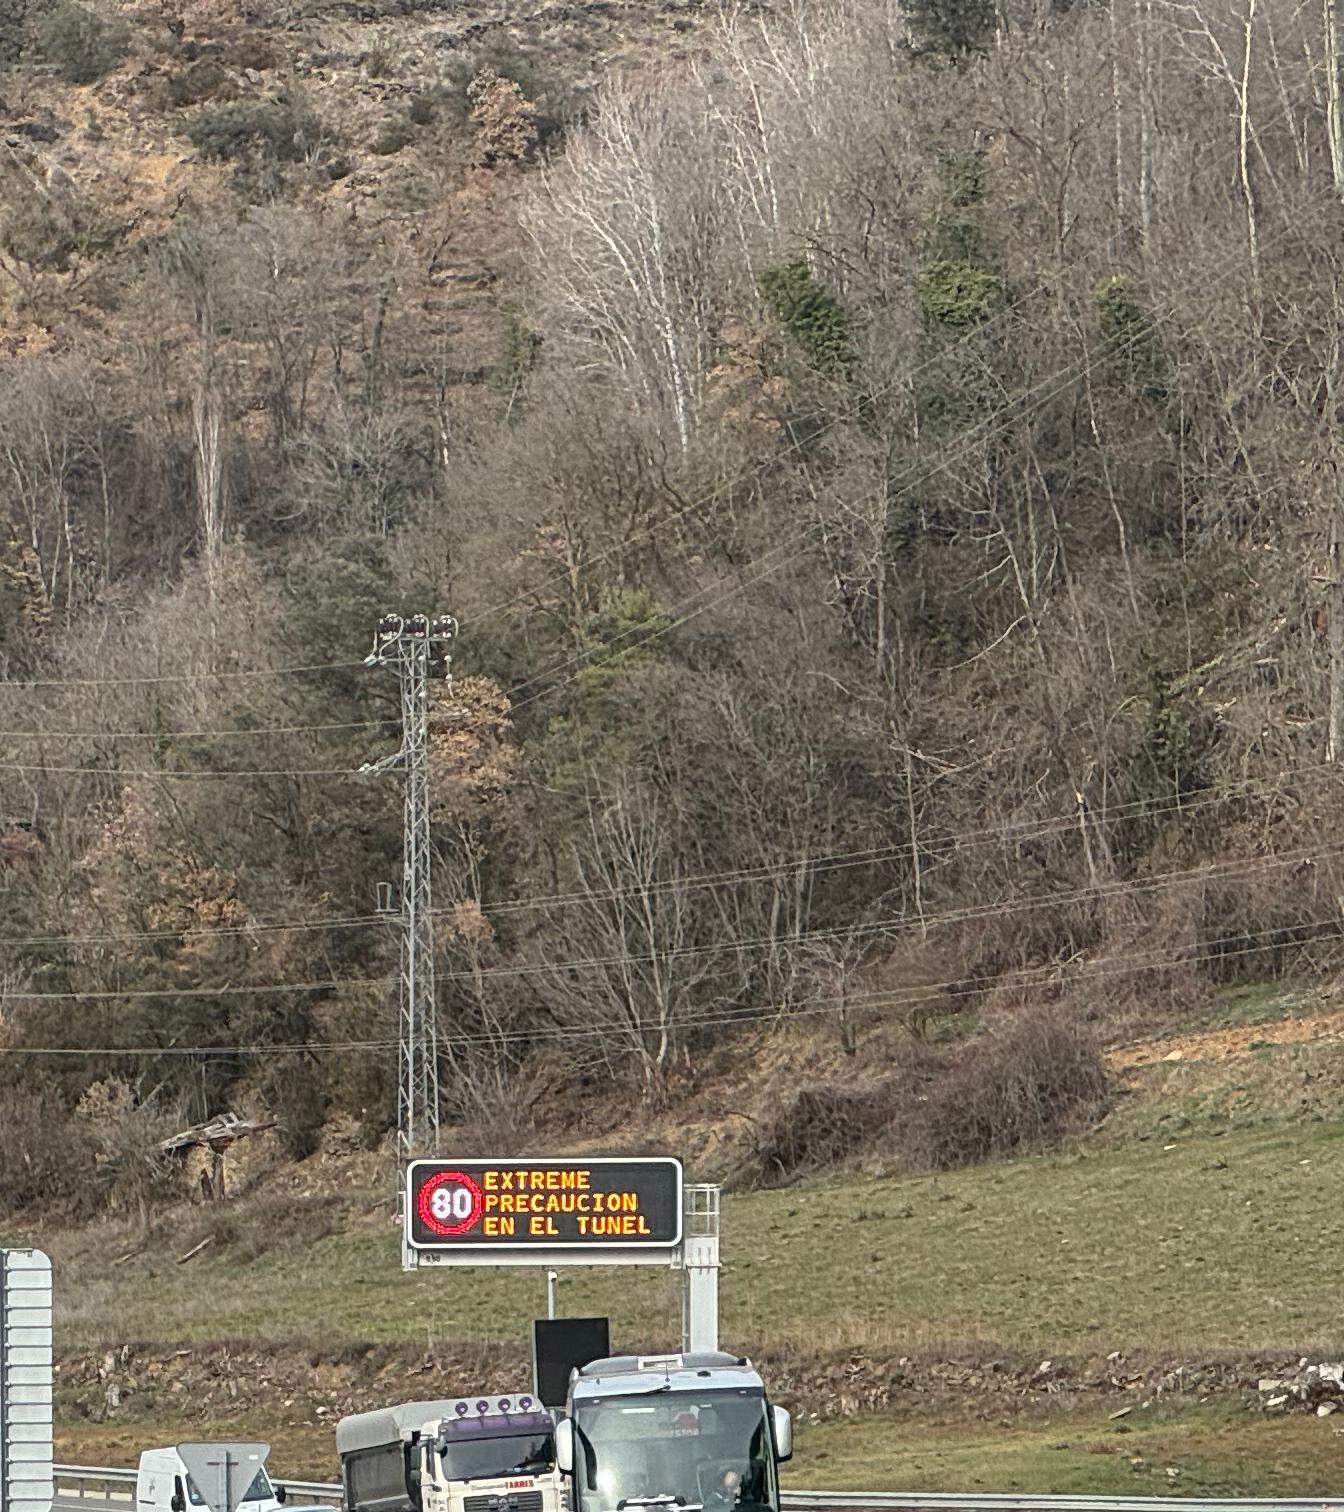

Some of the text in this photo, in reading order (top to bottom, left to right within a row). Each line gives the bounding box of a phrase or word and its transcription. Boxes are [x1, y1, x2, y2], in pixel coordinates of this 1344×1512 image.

[484, 1171, 591, 1190] EXTREME
[431, 1188, 472, 1219] 80
[485, 1193, 637, 1213] PRECAUCION
[484, 1216, 651, 1235] EN EL TUNEL
